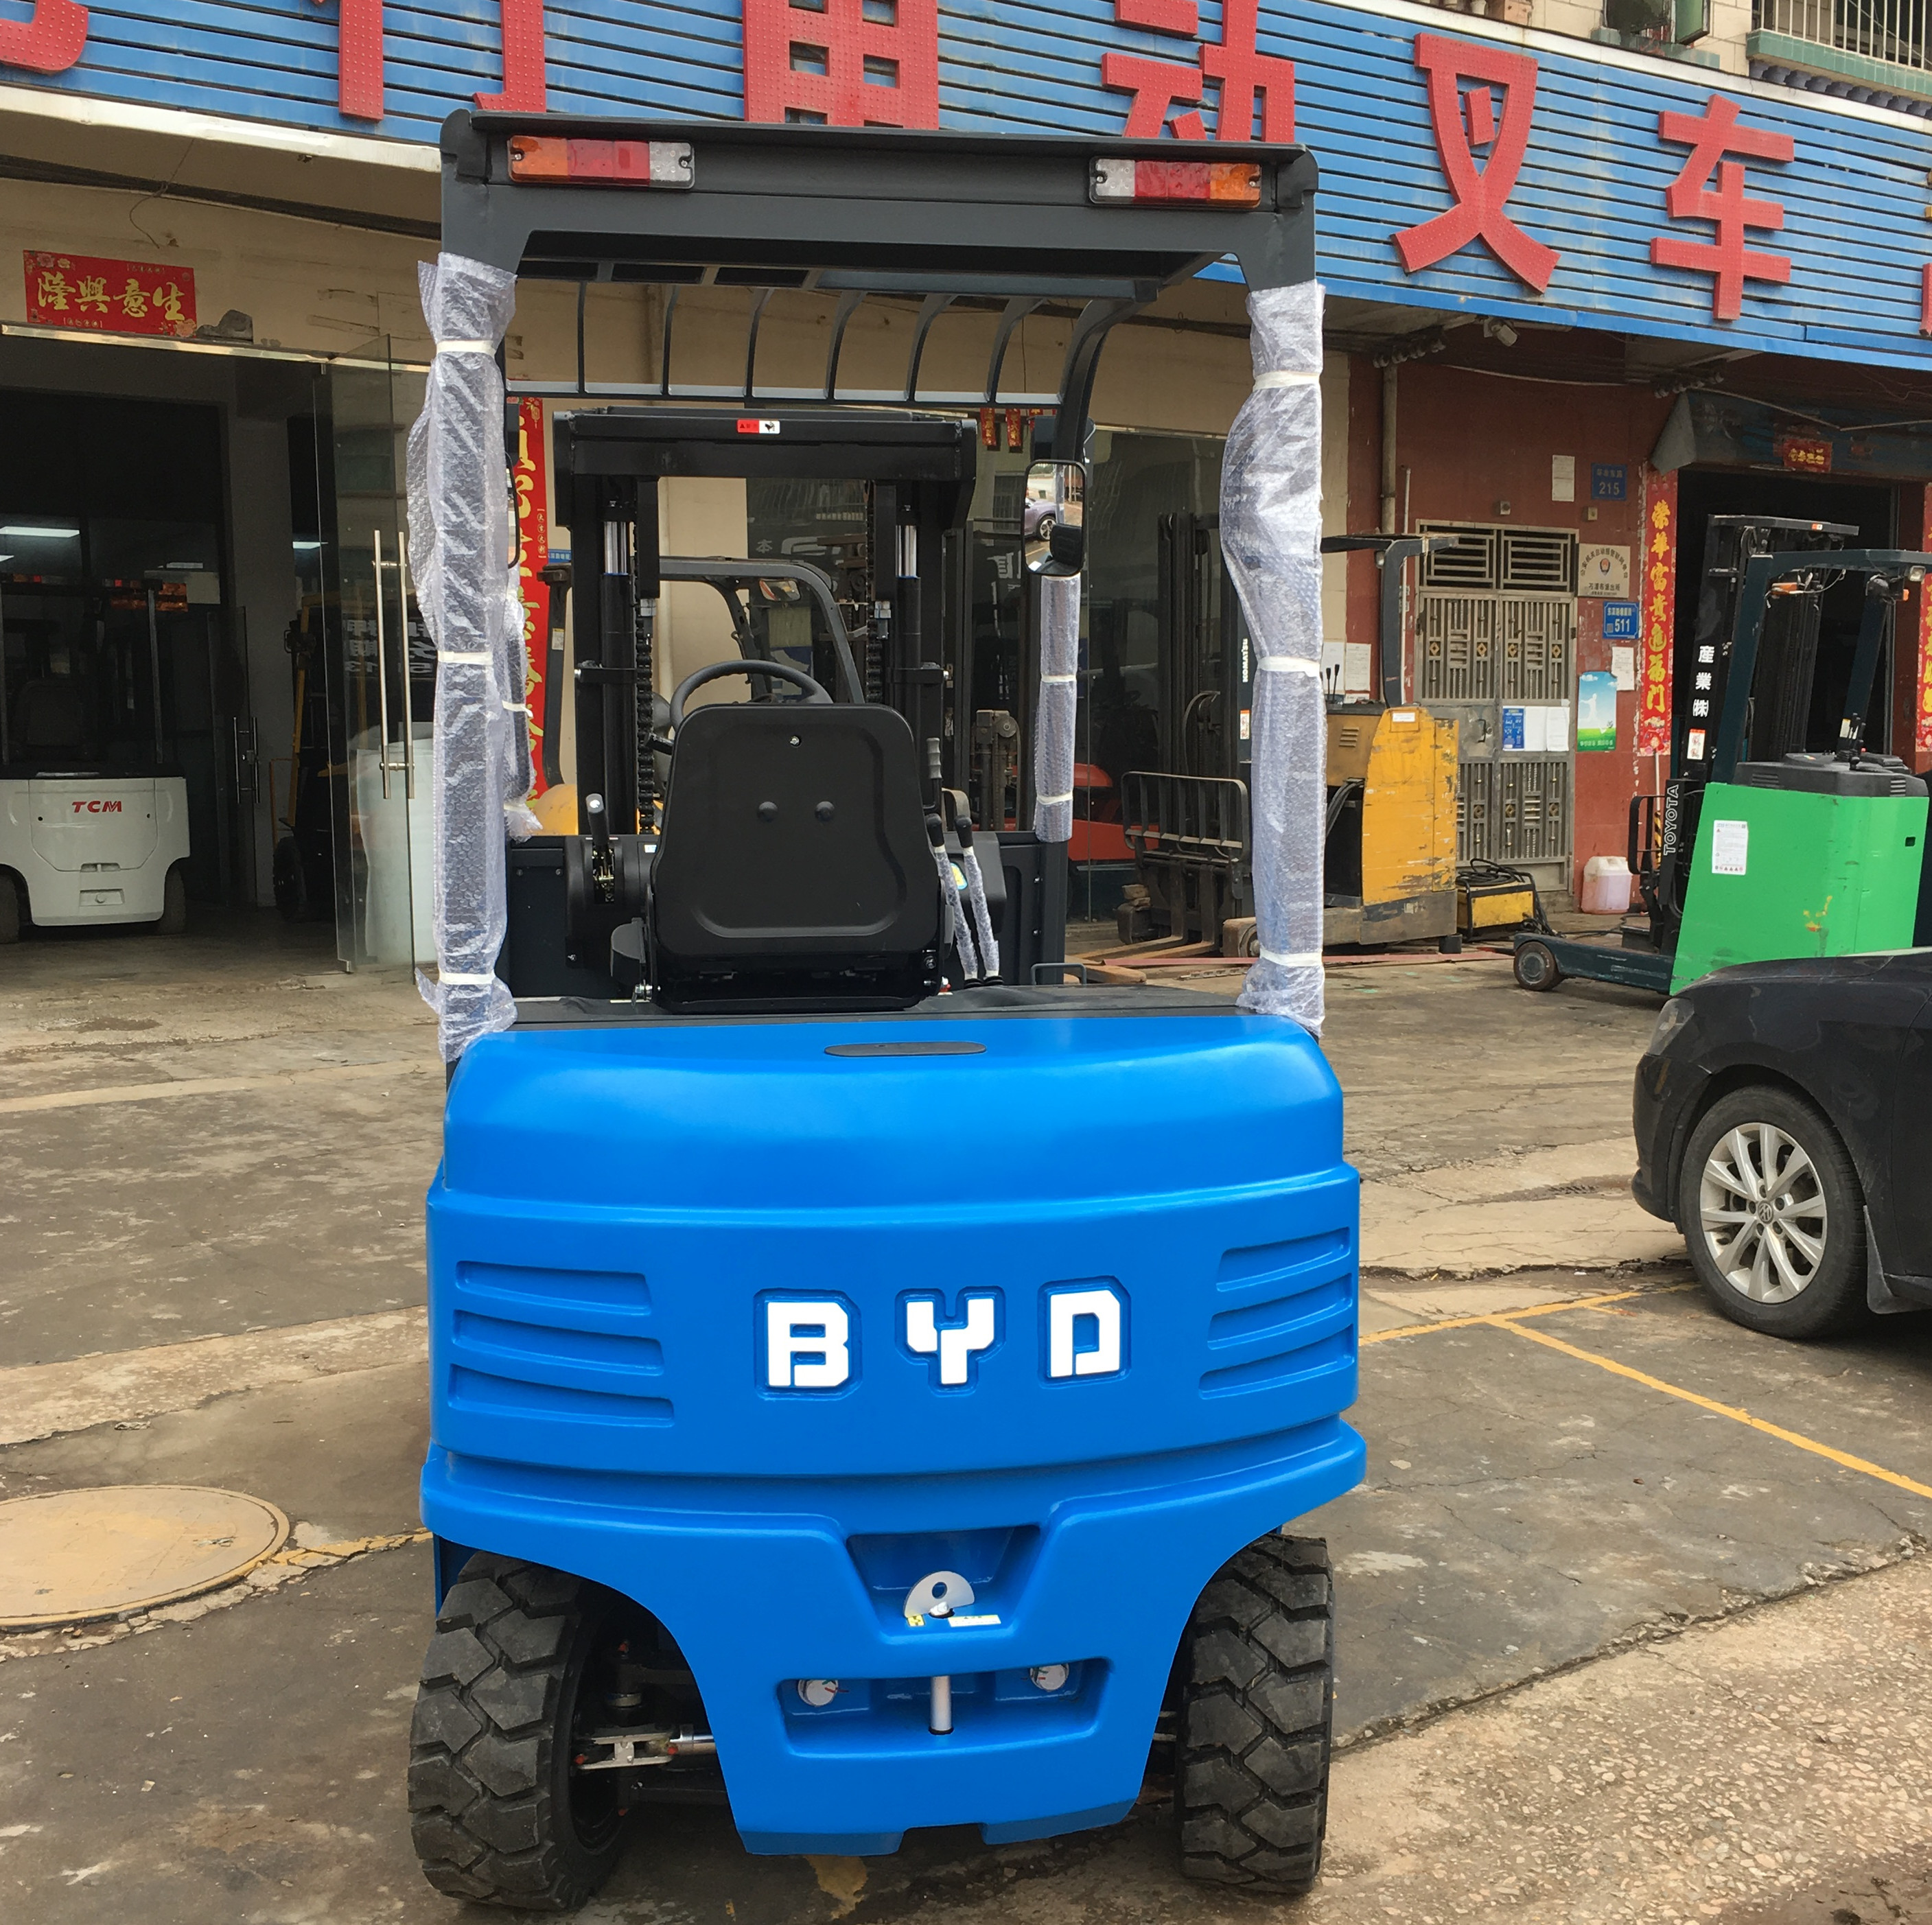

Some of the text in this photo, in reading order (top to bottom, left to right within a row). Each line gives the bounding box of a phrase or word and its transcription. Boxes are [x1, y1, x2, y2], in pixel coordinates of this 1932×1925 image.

[1599, 482, 1620, 495] 215
[1614, 618, 1630, 632] 511
[71, 800, 122, 813] TCM
[1664, 784, 1679, 856] TOYOTA
[767, 1290, 1121, 1387] BYD
